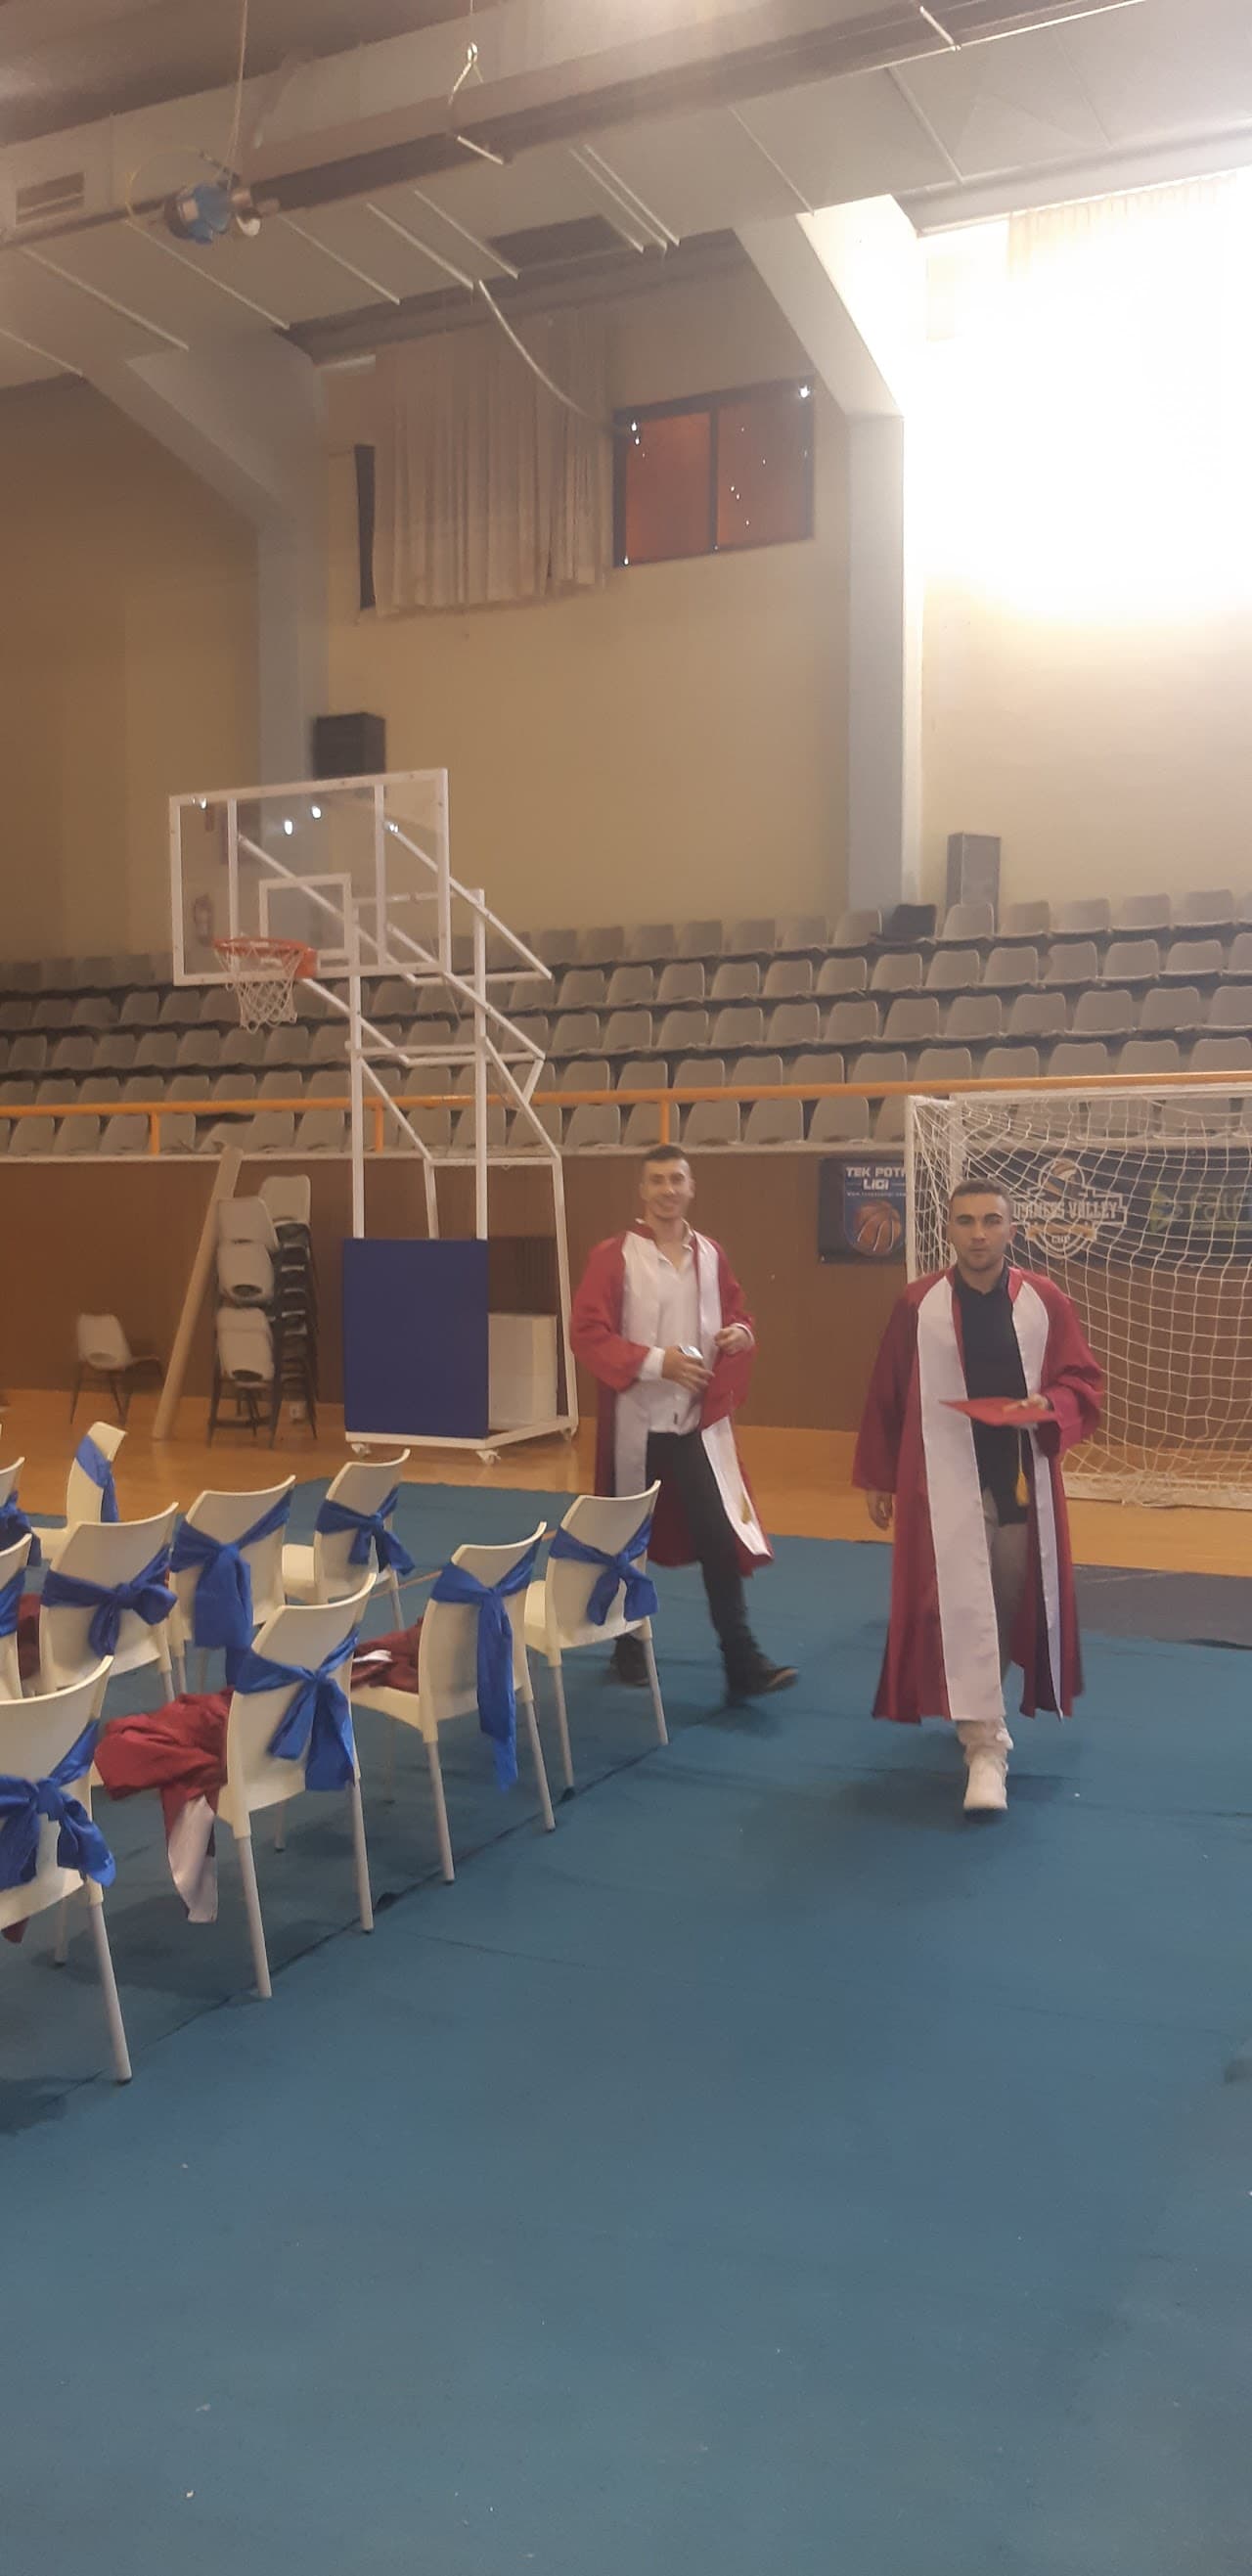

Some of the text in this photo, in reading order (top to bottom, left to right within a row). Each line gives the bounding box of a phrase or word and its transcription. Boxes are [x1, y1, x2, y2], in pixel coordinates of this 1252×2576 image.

[845, 1166, 871, 1178] TEK
[1012, 1200, 1117, 1219] USINESS VOLLEY
